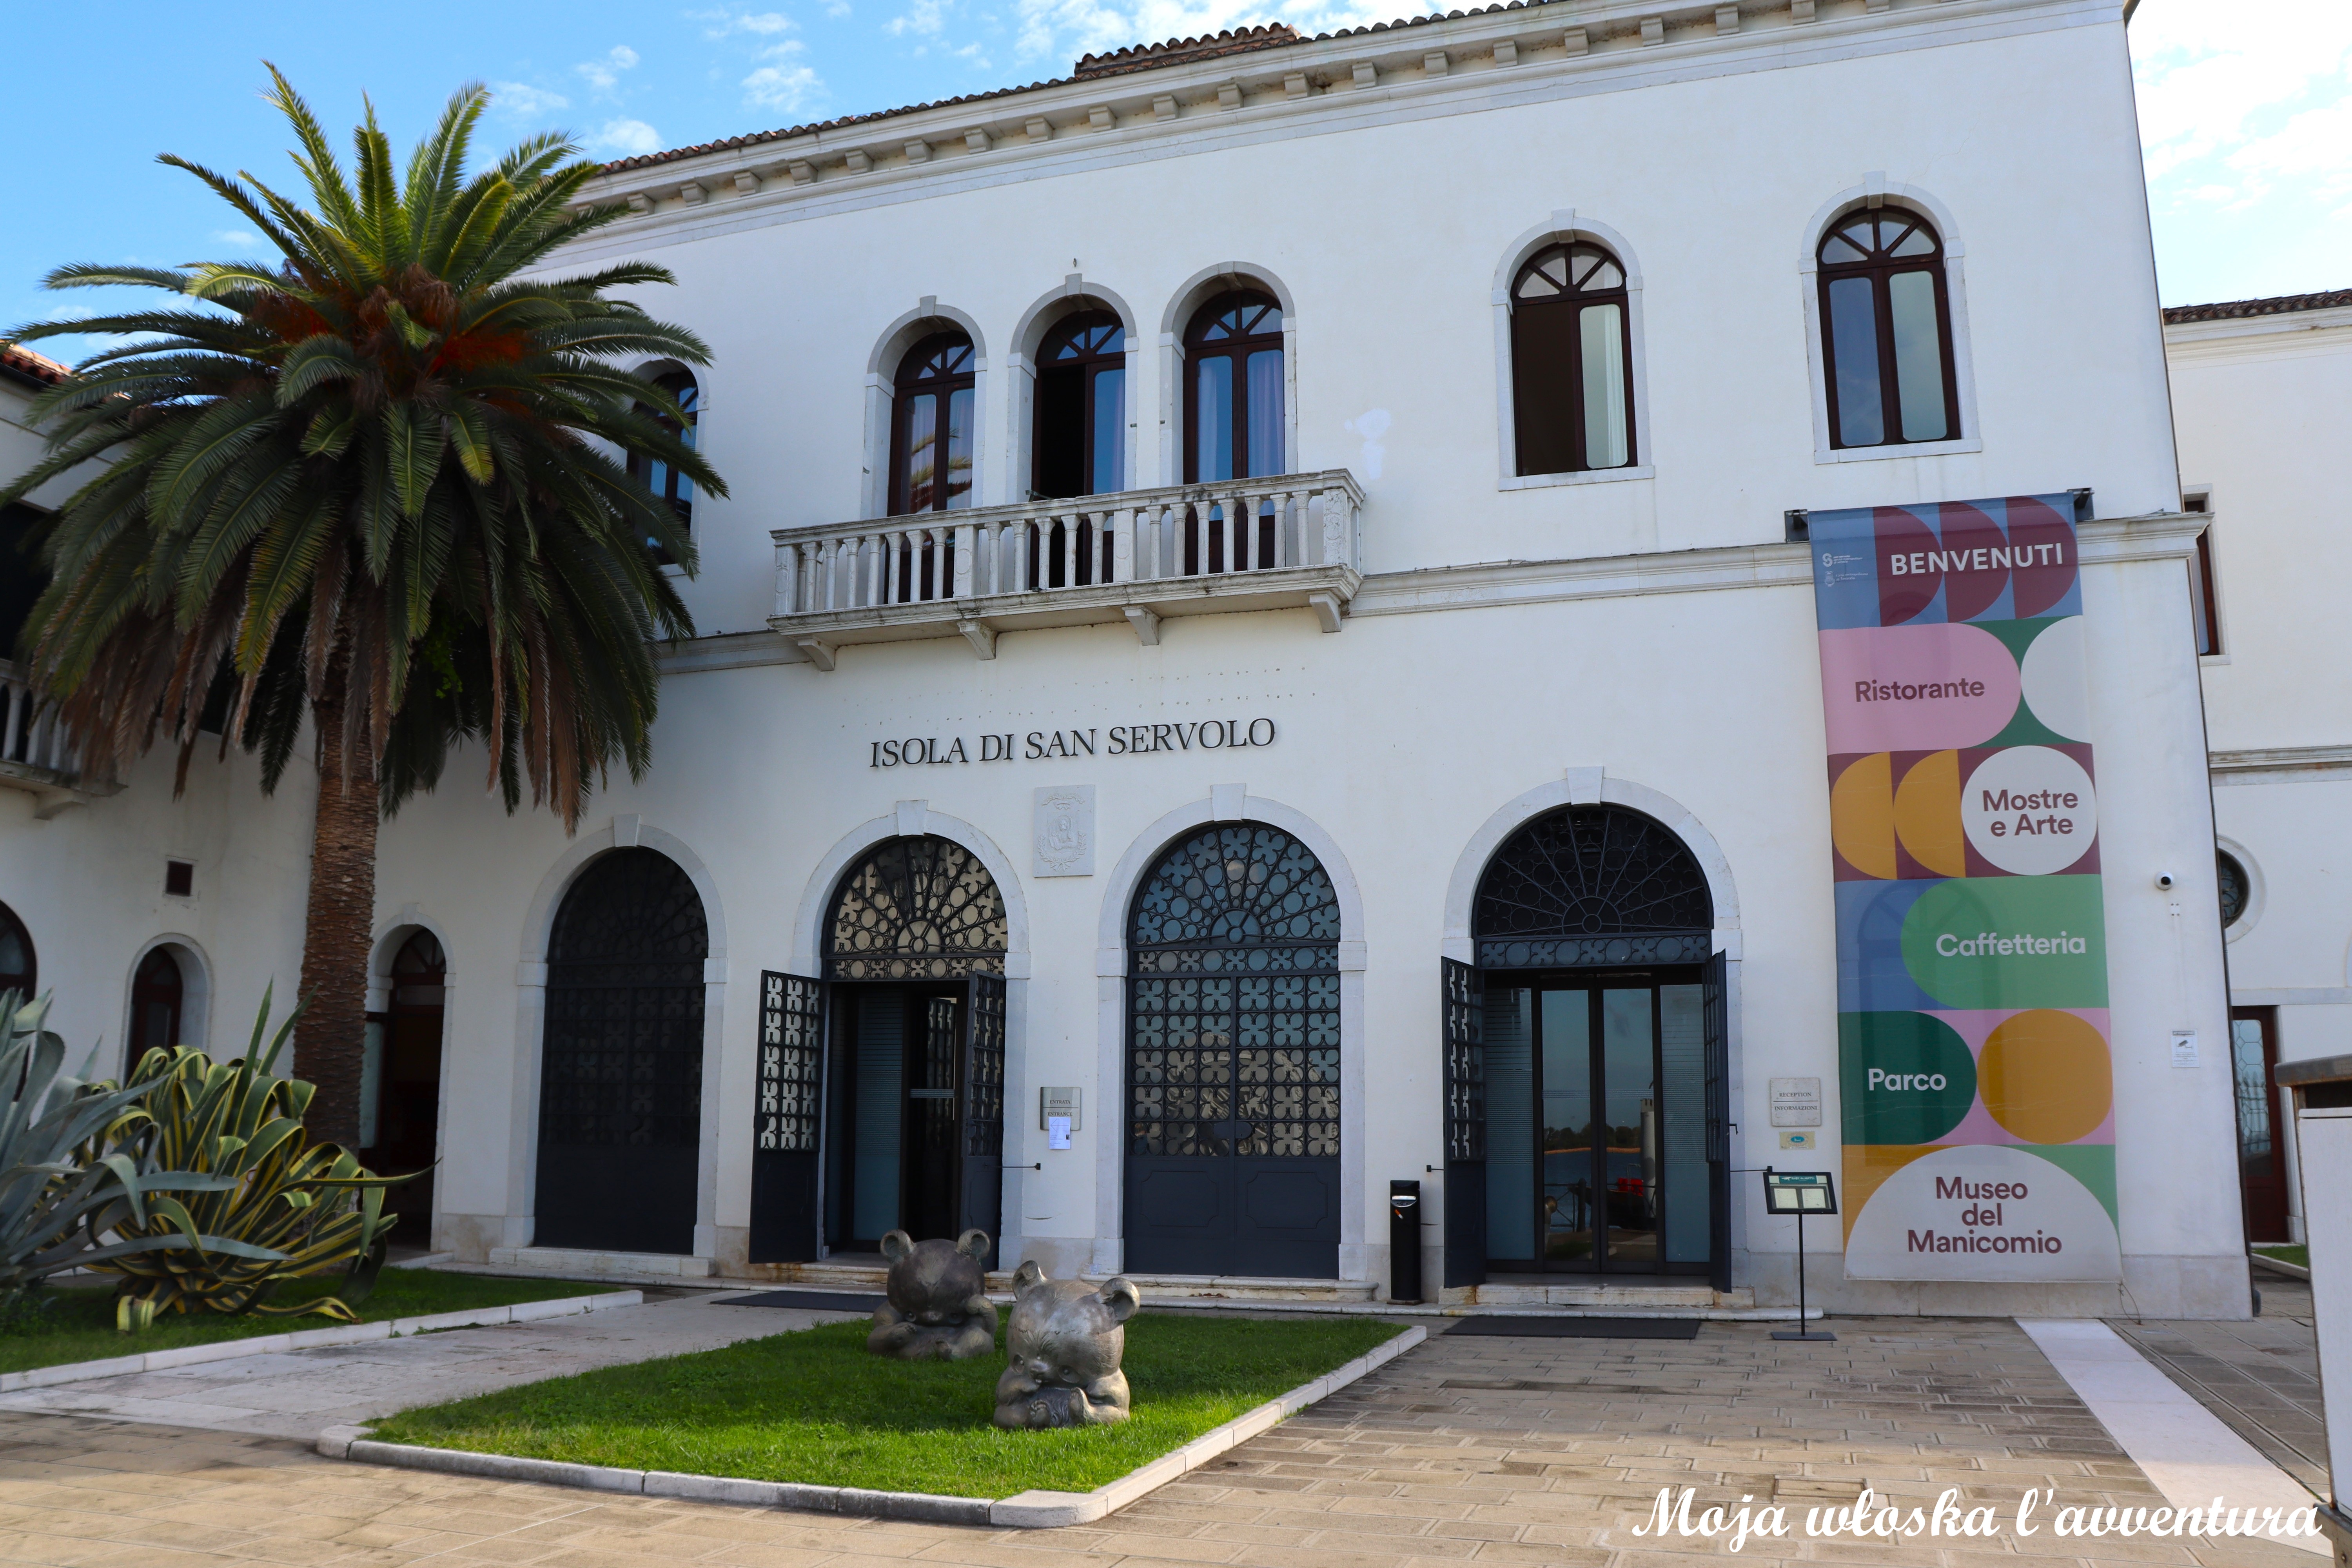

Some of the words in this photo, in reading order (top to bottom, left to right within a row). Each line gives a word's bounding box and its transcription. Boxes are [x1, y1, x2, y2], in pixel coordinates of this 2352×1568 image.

[1891, 543, 2063, 575] BENVENUTI
[1855, 678, 1985, 702] Ristorante
[869, 737, 969, 768] ISOLA
[979, 734, 1014, 761] DI
[1025, 728, 1097, 759] SAN
[1108, 718, 1276, 755] SERVOLO
[1983, 789, 2078, 811] Mostre
[1991, 821, 2006, 837] e
[2014, 813, 2073, 836] Arte
[1936, 931, 2086, 956] Caffetteria
[1868, 1068, 1947, 1091] Parco
[1936, 1176, 2028, 1200] Museo
[1962, 1203, 2002, 1226] del
[1908, 1229, 2062, 1254] Manicomio
